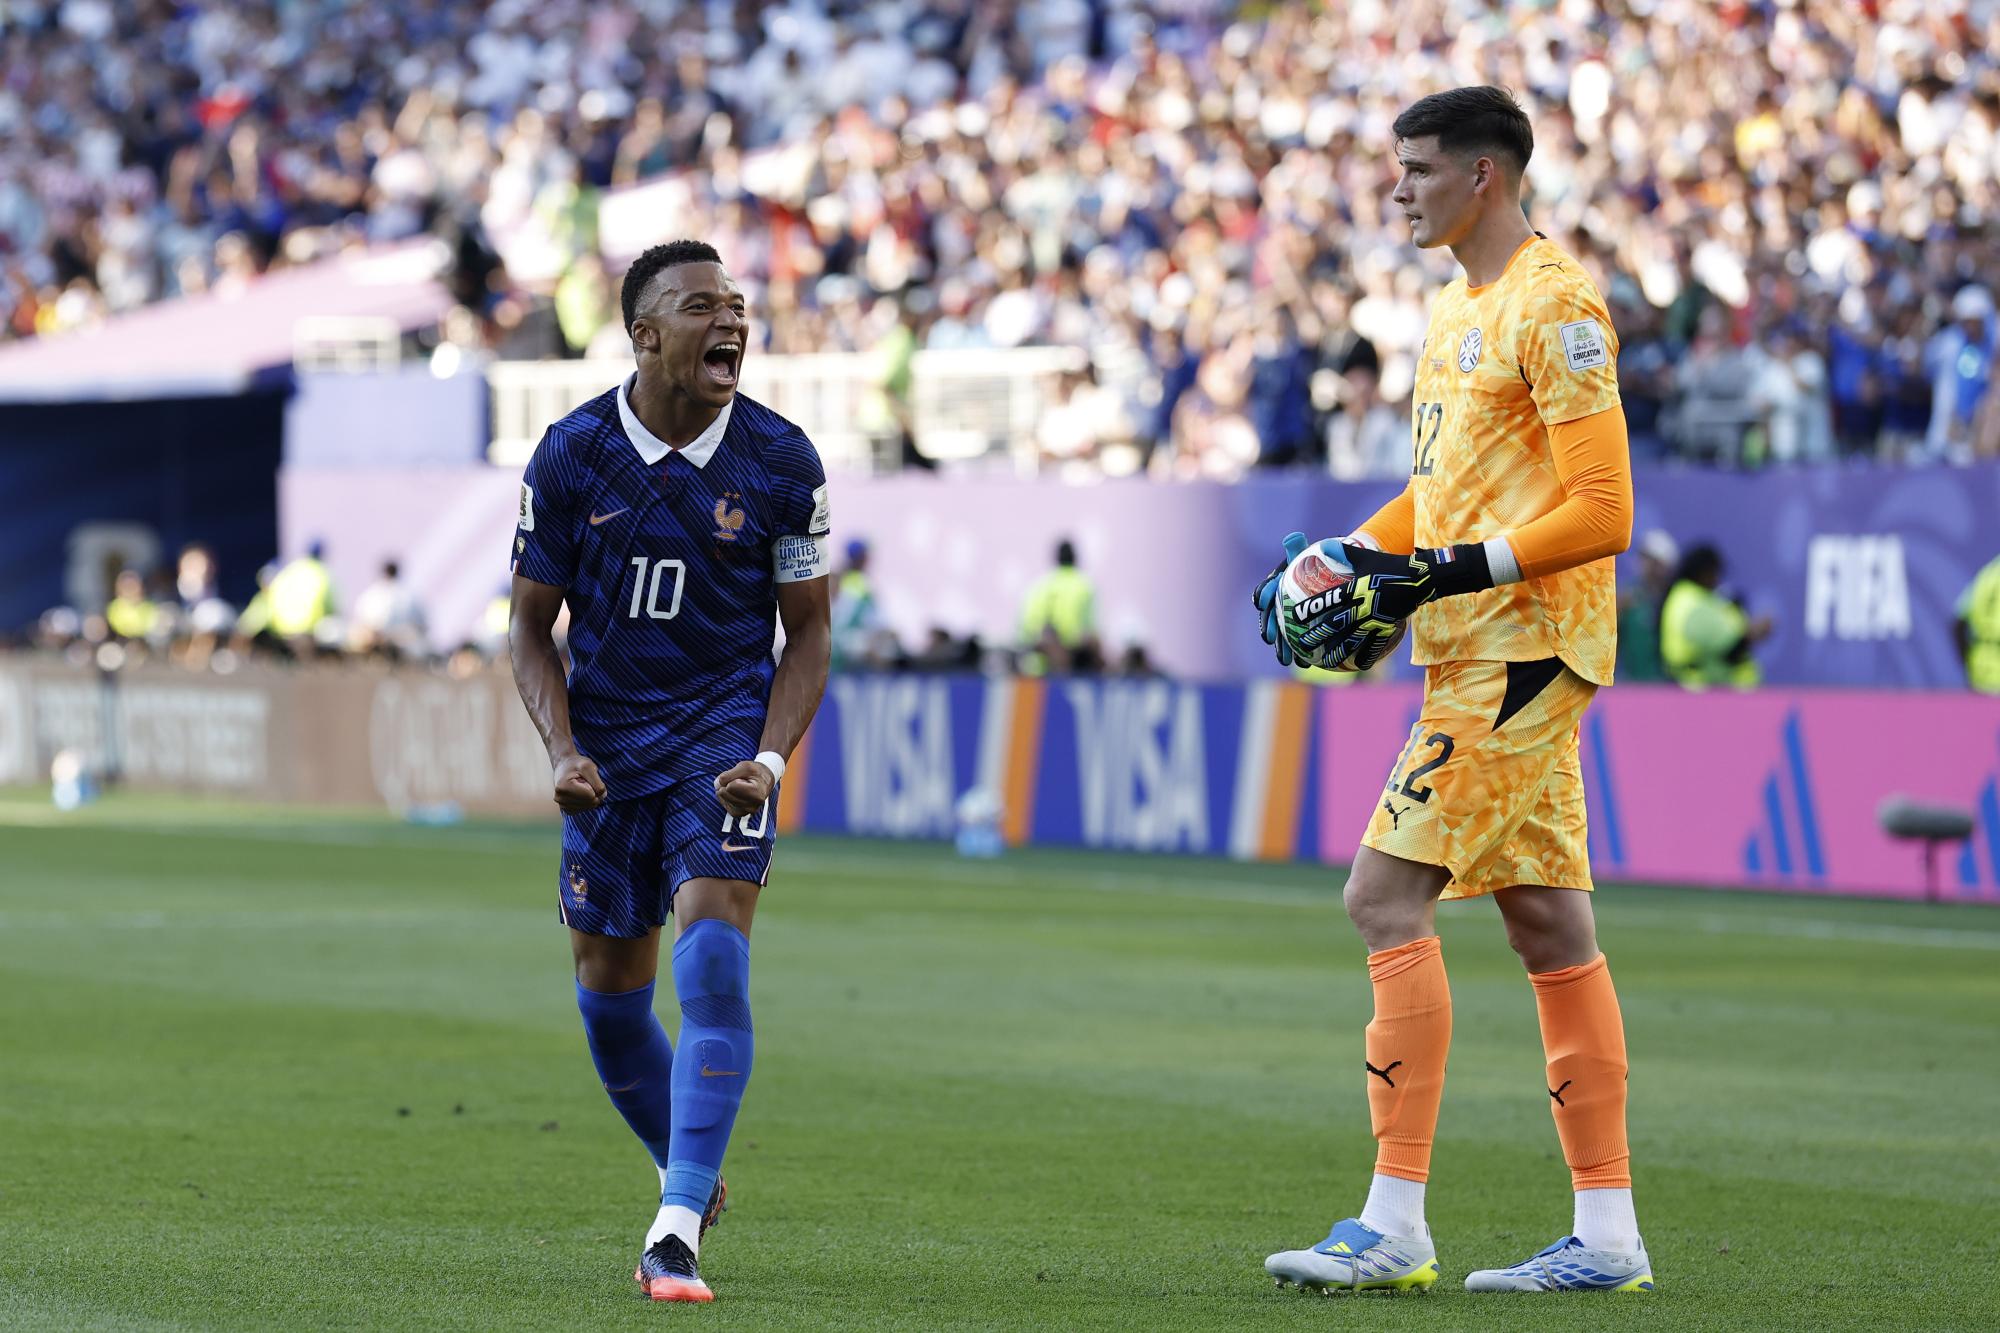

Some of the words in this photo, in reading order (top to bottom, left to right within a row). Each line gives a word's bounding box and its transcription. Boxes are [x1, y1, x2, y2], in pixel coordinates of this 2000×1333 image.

[1572, 349, 1601, 361] EDUCATION
[1412, 402, 1443, 476] 12
[778, 560, 795, 571] the
[796, 554, 820, 569] World
[779, 543, 817, 560] UNITES
[629, 556, 686, 620] 10
[1294, 587, 1342, 622] Voit
[1804, 534, 1911, 640] FIFA
[834, 674, 956, 836] VISA
[1066, 679, 1211, 851] VISA
[1387, 725, 1455, 804] 12
